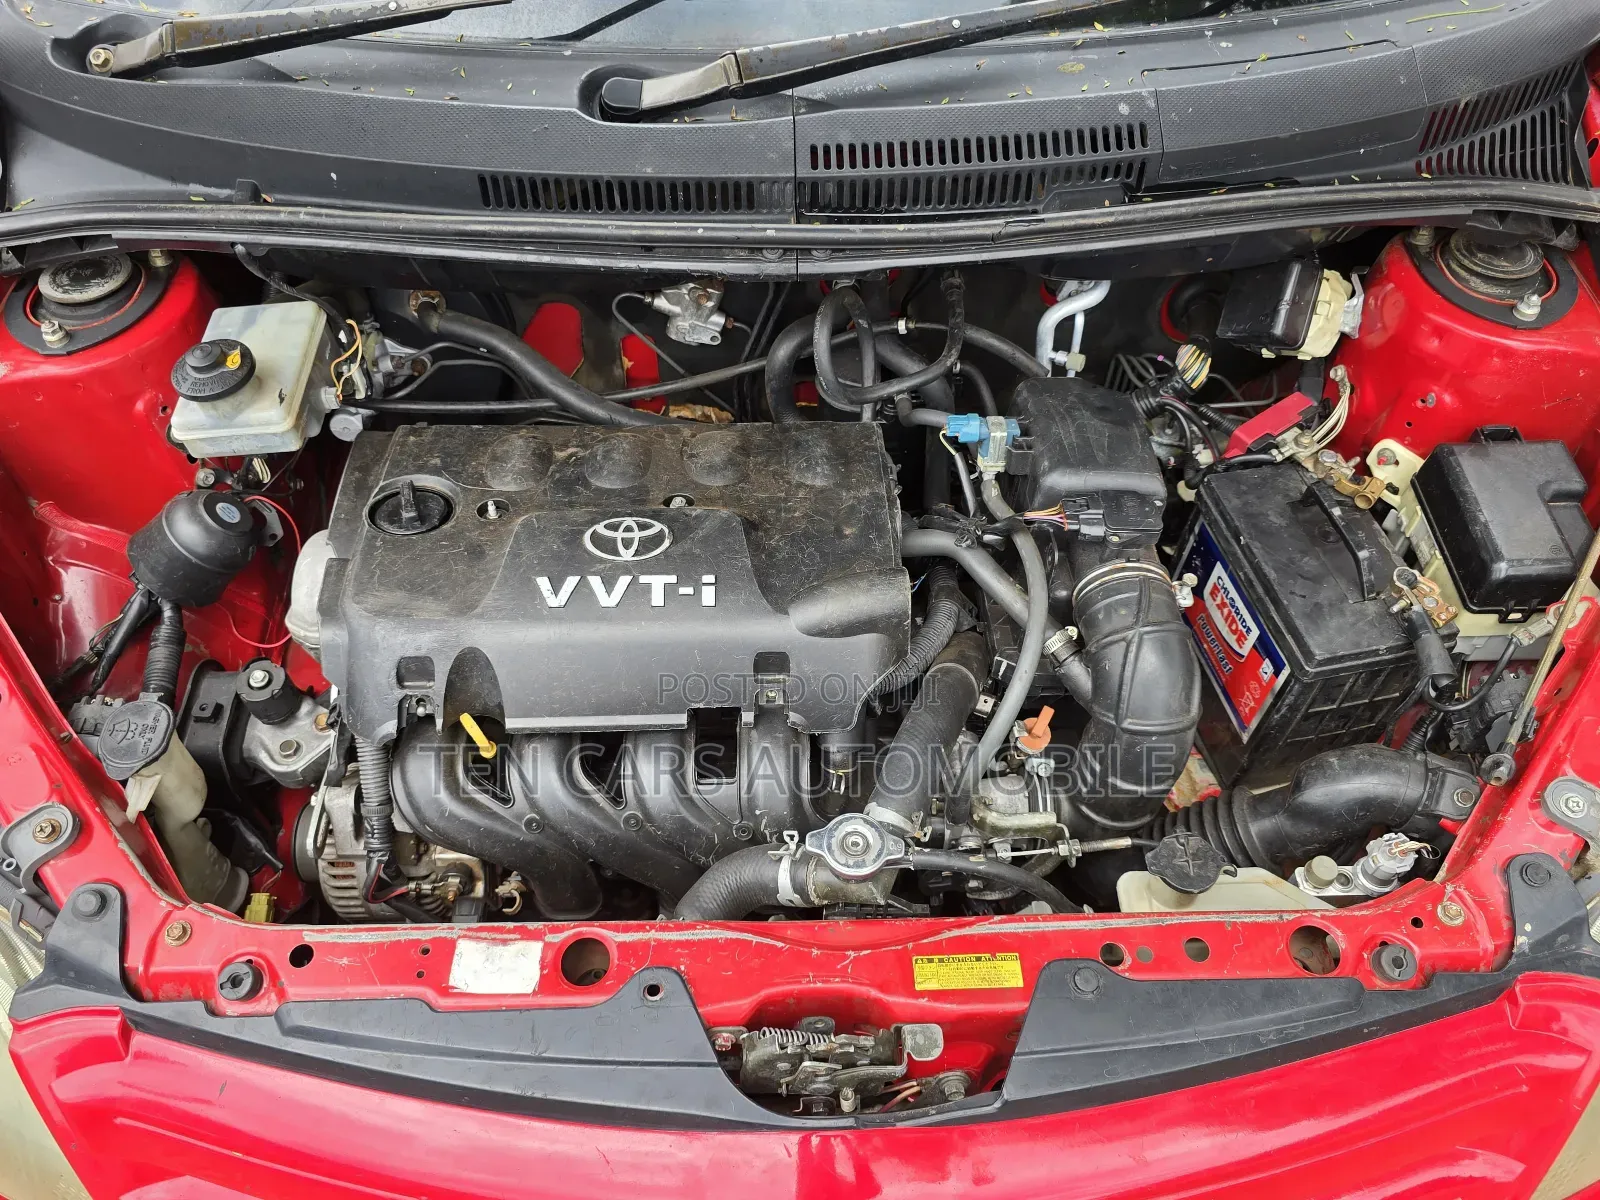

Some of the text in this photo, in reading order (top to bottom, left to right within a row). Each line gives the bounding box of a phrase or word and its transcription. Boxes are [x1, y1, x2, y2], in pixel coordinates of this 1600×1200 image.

[534, 574, 717, 609] VVT-i
[1208, 582, 1249, 650] EXIDE
[1217, 575, 1253, 637] CHLORIDE
